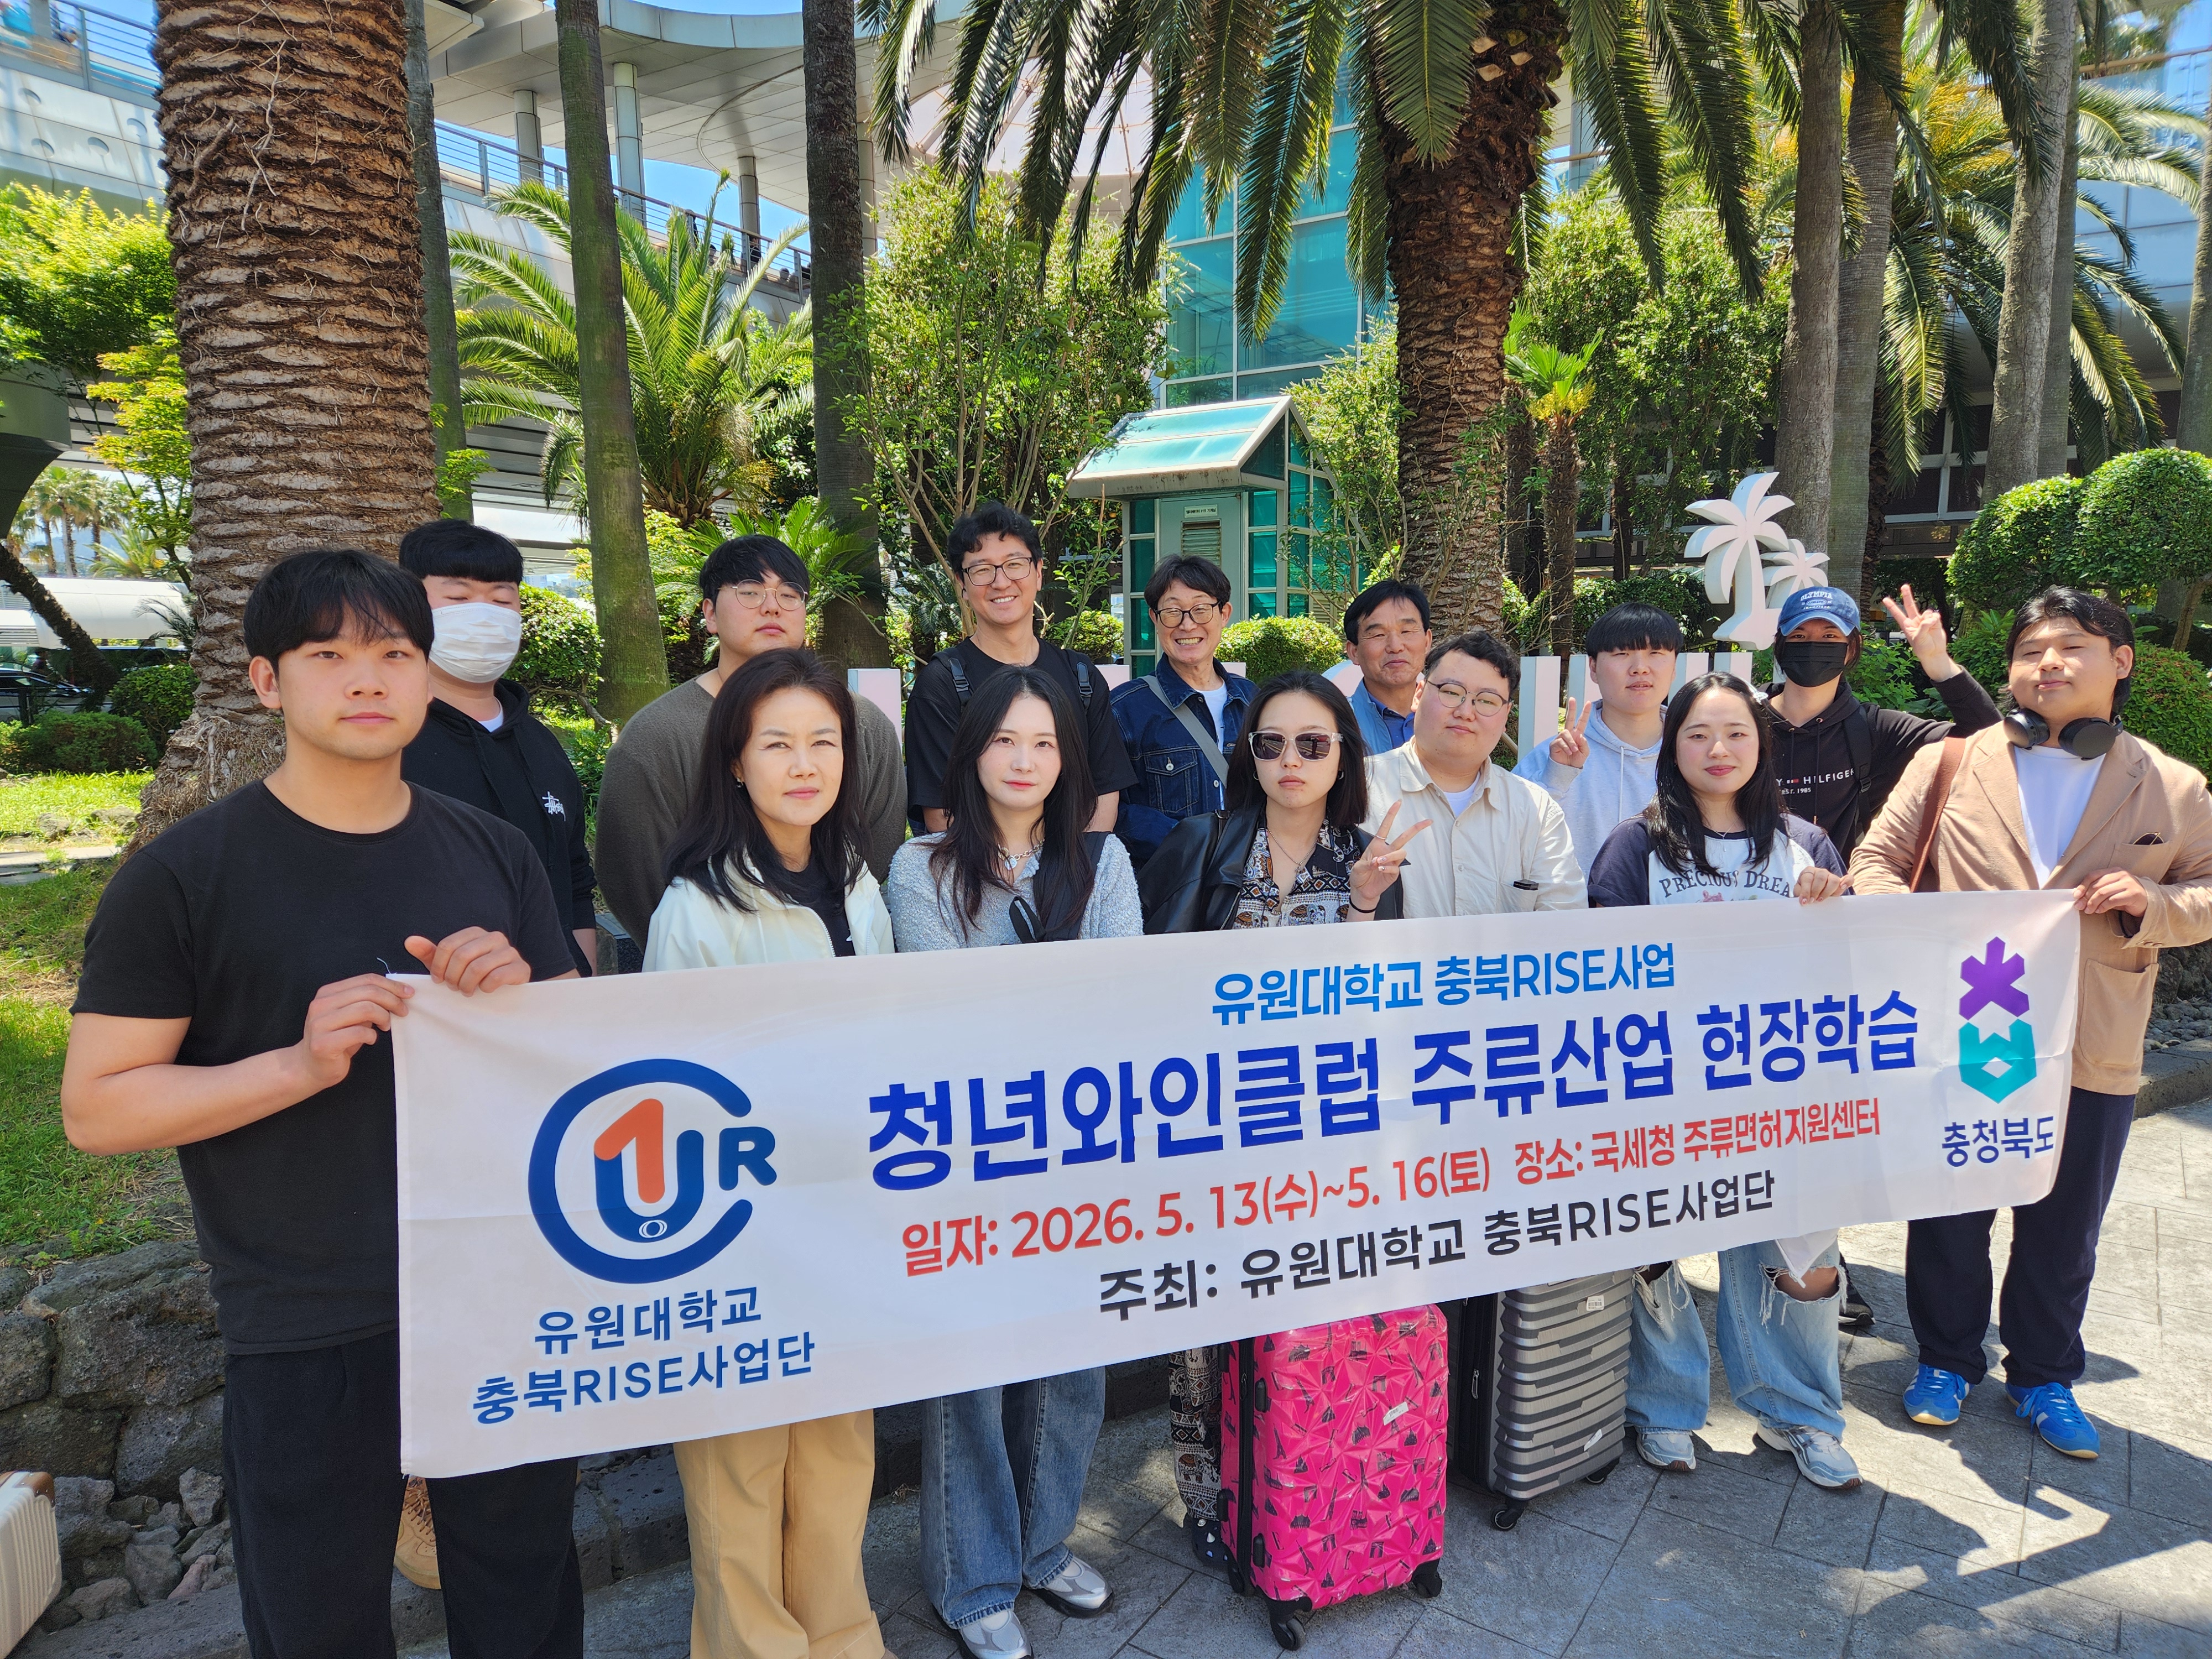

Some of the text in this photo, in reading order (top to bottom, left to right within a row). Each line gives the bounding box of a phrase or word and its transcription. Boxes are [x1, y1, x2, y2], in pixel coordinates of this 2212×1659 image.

[1801, 591, 1833, 601] OLYMPIA
[1659, 869, 1739, 898] PRECIOUS
[1212, 942, 1674, 1026] 유원대학교 충북RISE사업
[869, 990, 1918, 1191] 청년와인클럽 주류산업 현장학습
[1942, 1116, 2054, 1167] 충청북도
[902, 1098, 1880, 1276] 일자: 2026. 5. 13(수)~5. 16(토) 장소: 국세청 주류면허지원센터
[1099, 1170, 1775, 1321] 주최: 유원대학교 충북RISE사업단
[535, 1286, 761, 1355] 유원대학교
[473, 1331, 815, 1425] 충북RISE사업단
